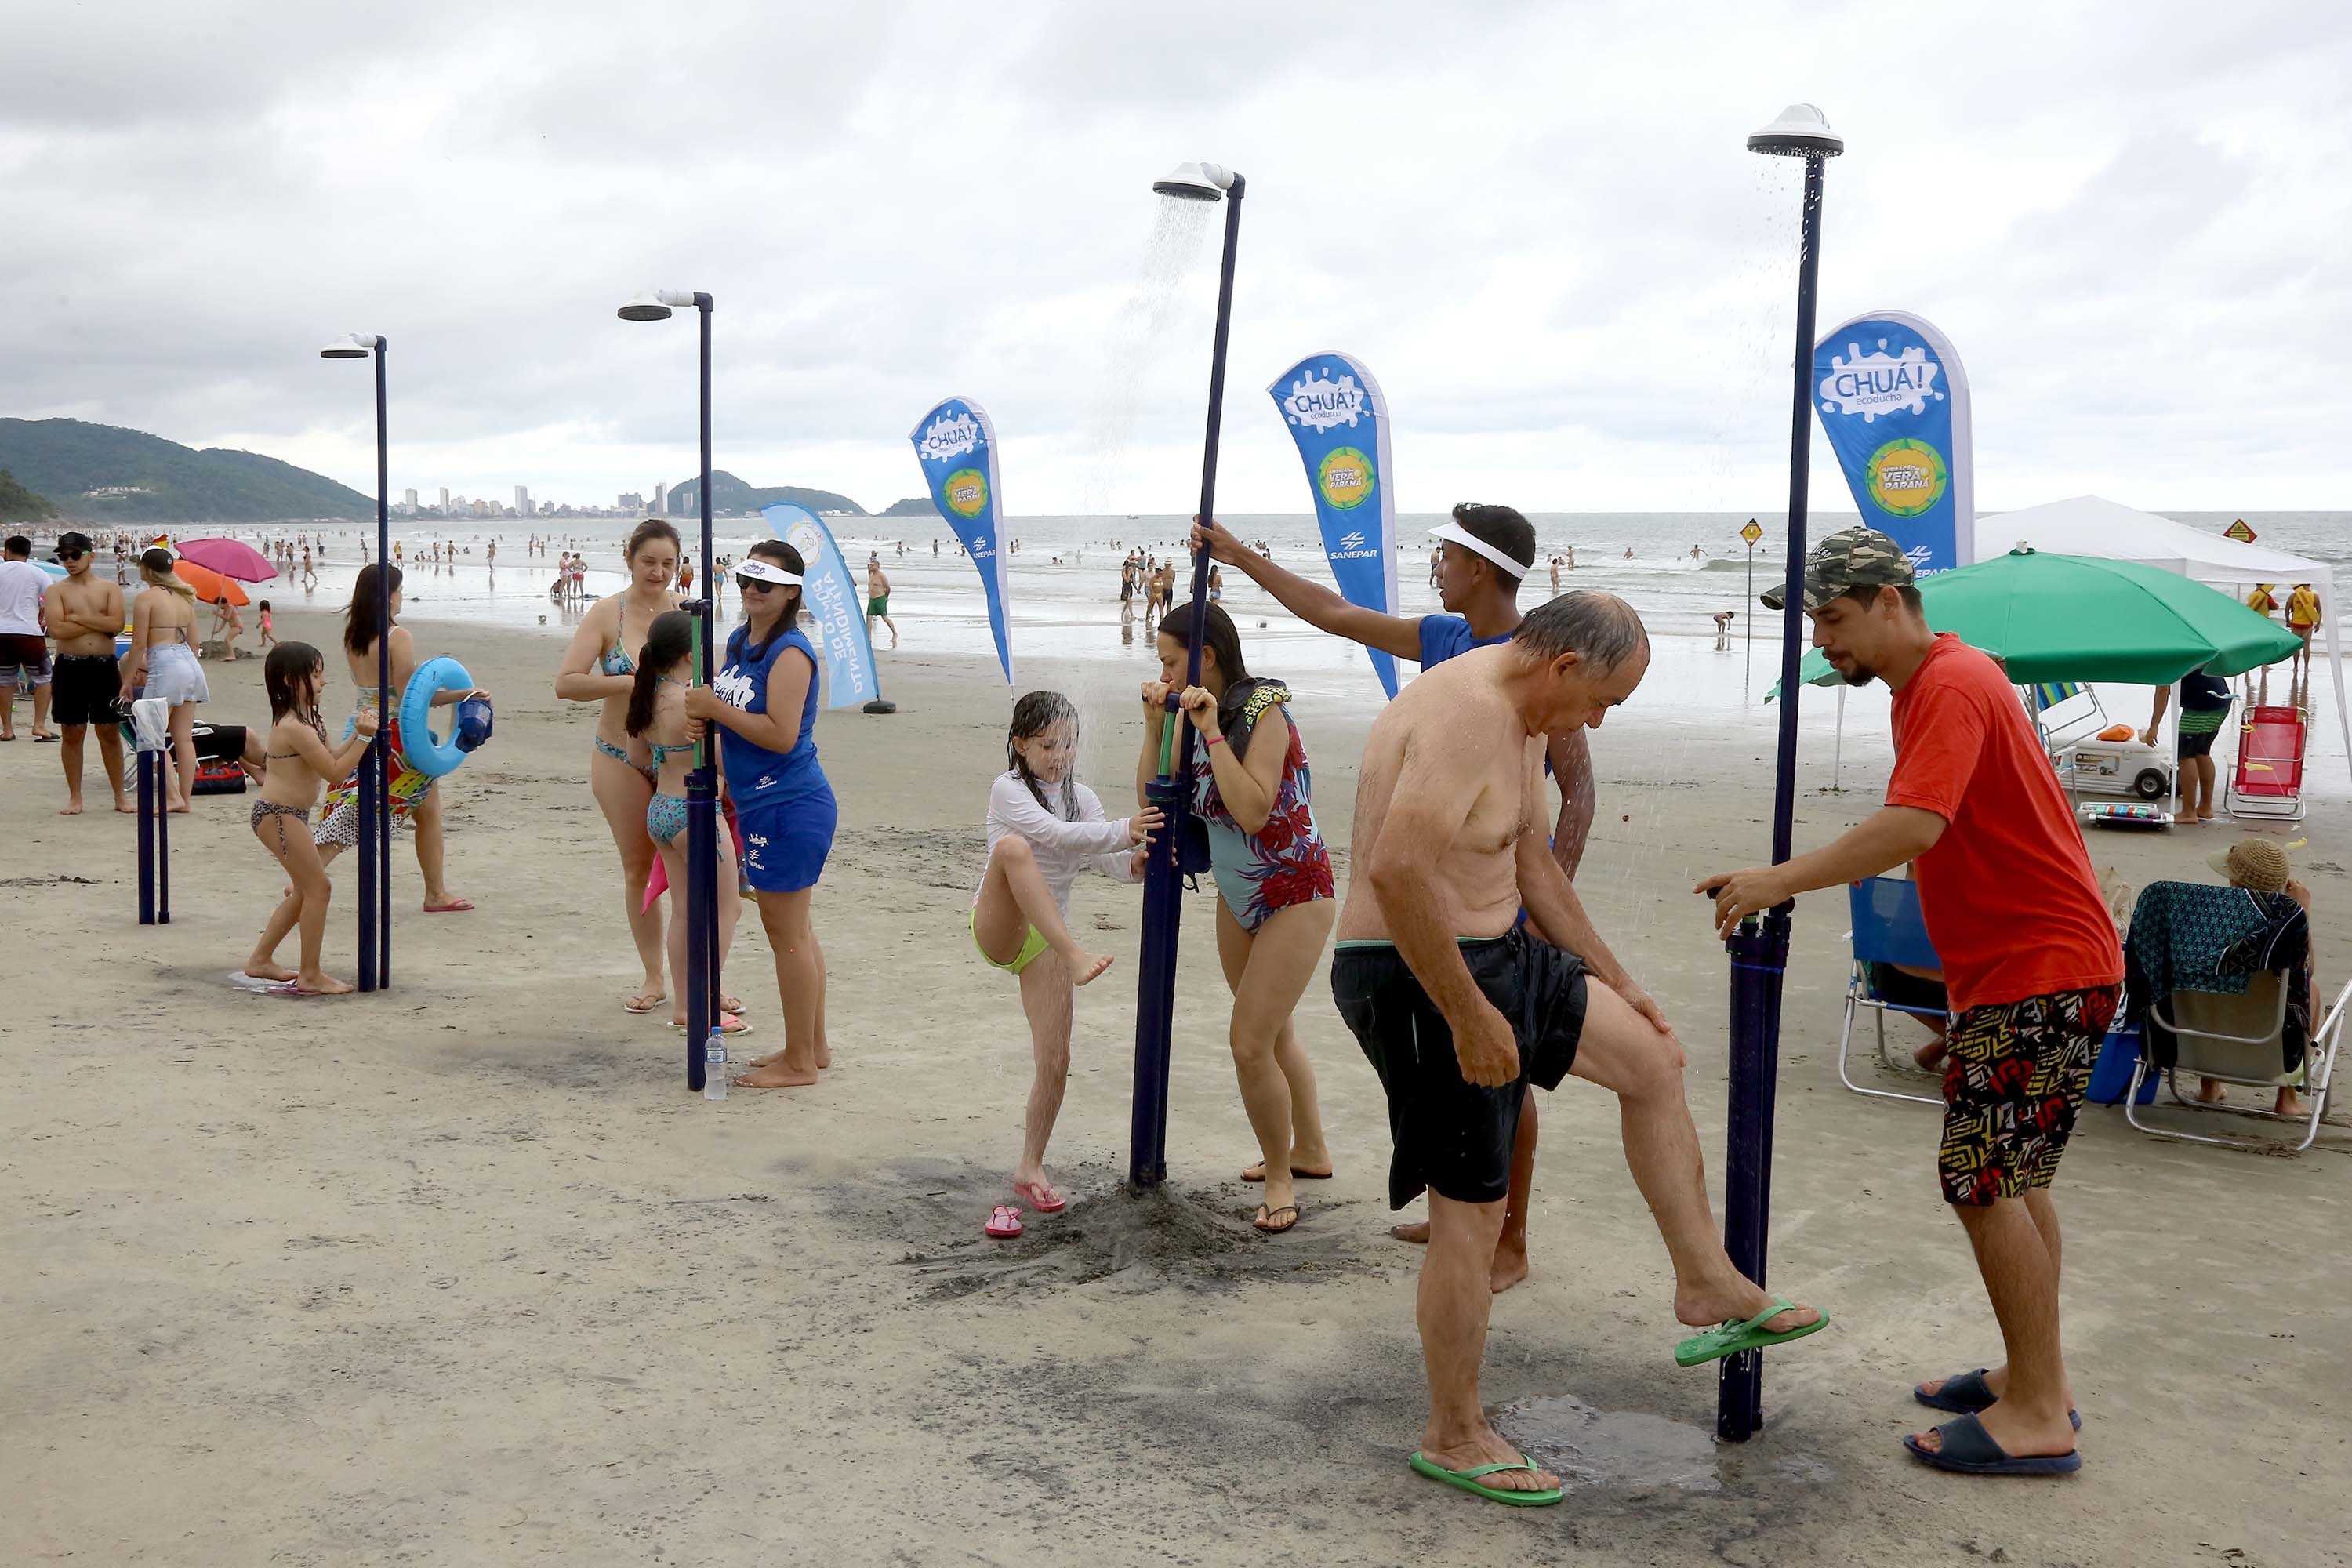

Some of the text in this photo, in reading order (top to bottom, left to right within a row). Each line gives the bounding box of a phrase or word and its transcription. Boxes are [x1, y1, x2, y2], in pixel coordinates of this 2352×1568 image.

[1835, 362, 1923, 397] CHUÁ!
[1295, 387, 1355, 412] CHUÁ!
[1857, 393, 1902, 405] ecoducha
[928, 423, 971, 449] CHUÁ!
[1330, 477, 1362, 488] PARANÁ
[1884, 477, 1929, 490] PARANÁ
[1330, 550, 1377, 560] SANEPAR
[714, 684, 744, 708] HUÁ!
